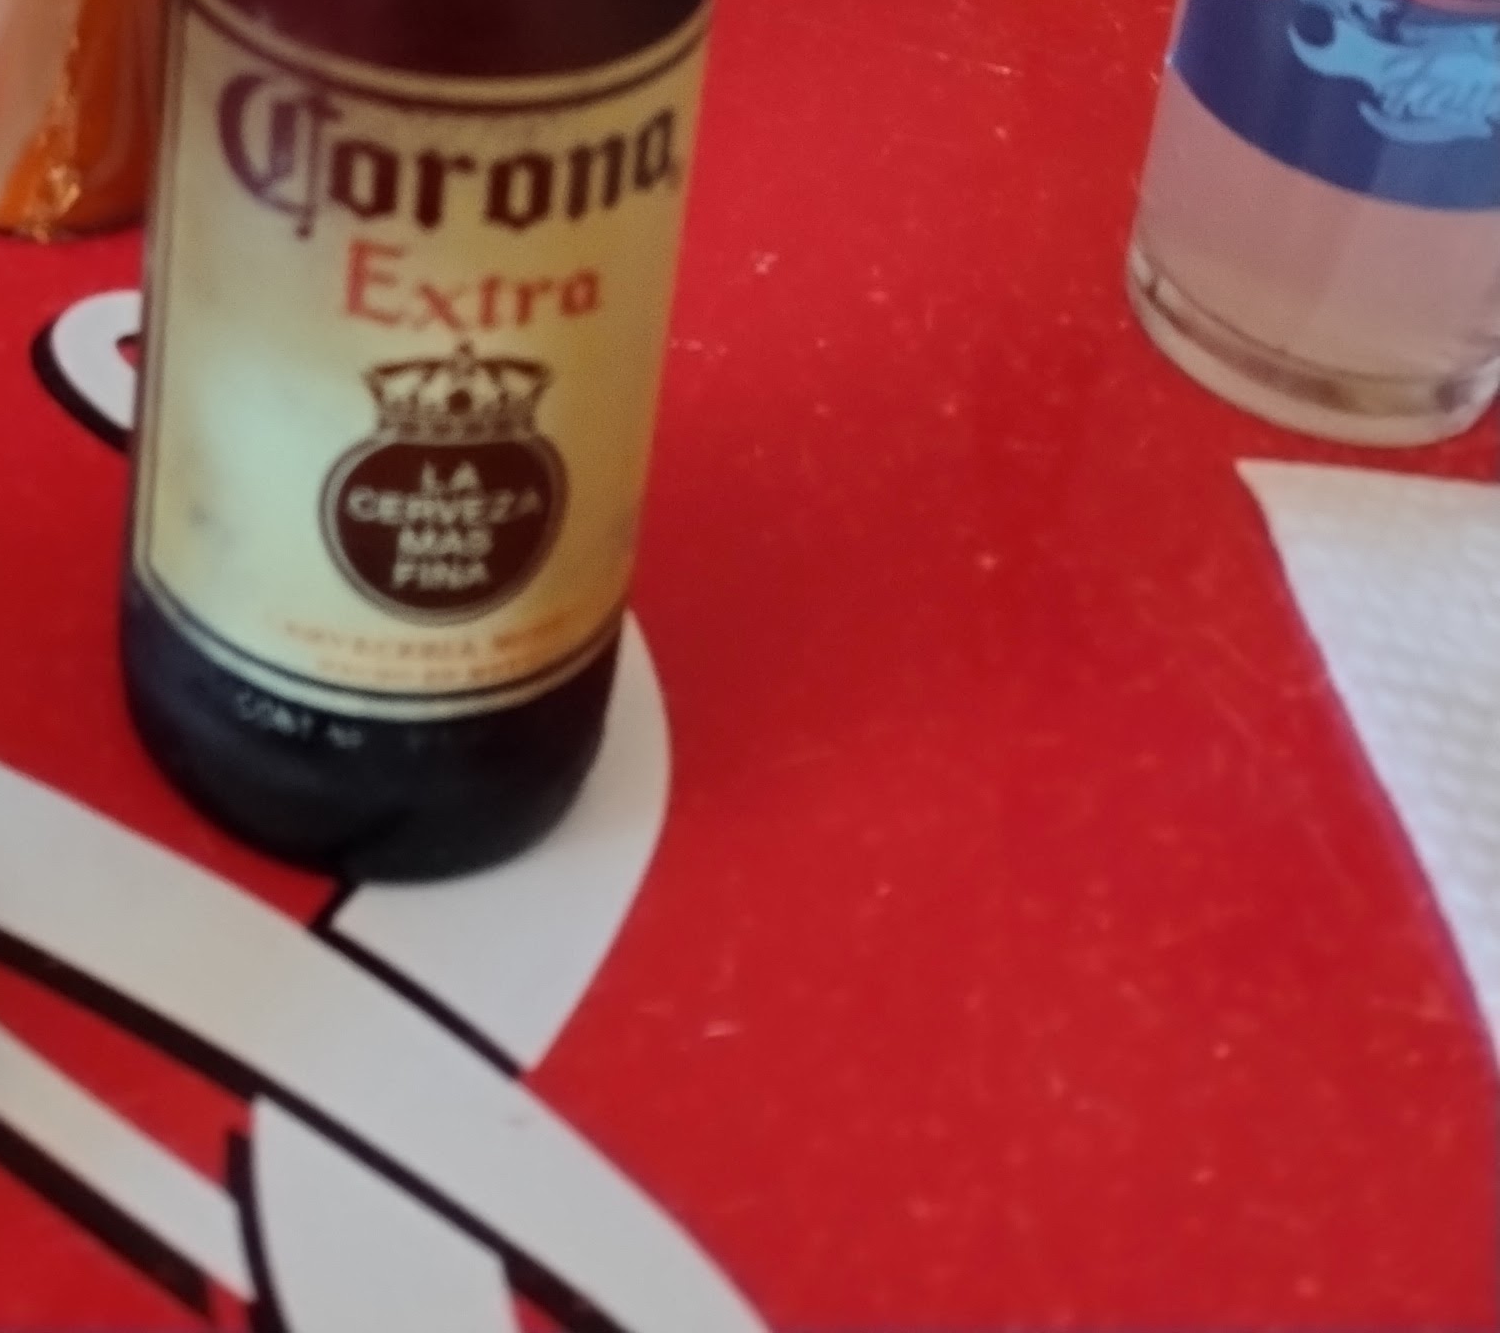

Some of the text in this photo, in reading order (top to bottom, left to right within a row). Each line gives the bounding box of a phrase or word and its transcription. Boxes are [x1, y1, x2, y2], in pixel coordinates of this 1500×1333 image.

[217, 73, 678, 239] Corona
[345, 238, 600, 332] Extra
[421, 460, 483, 498] LA
[347, 486, 543, 525] CERVEZA
[398, 527, 493, 556] MAS
[392, 562, 491, 590] FINA
